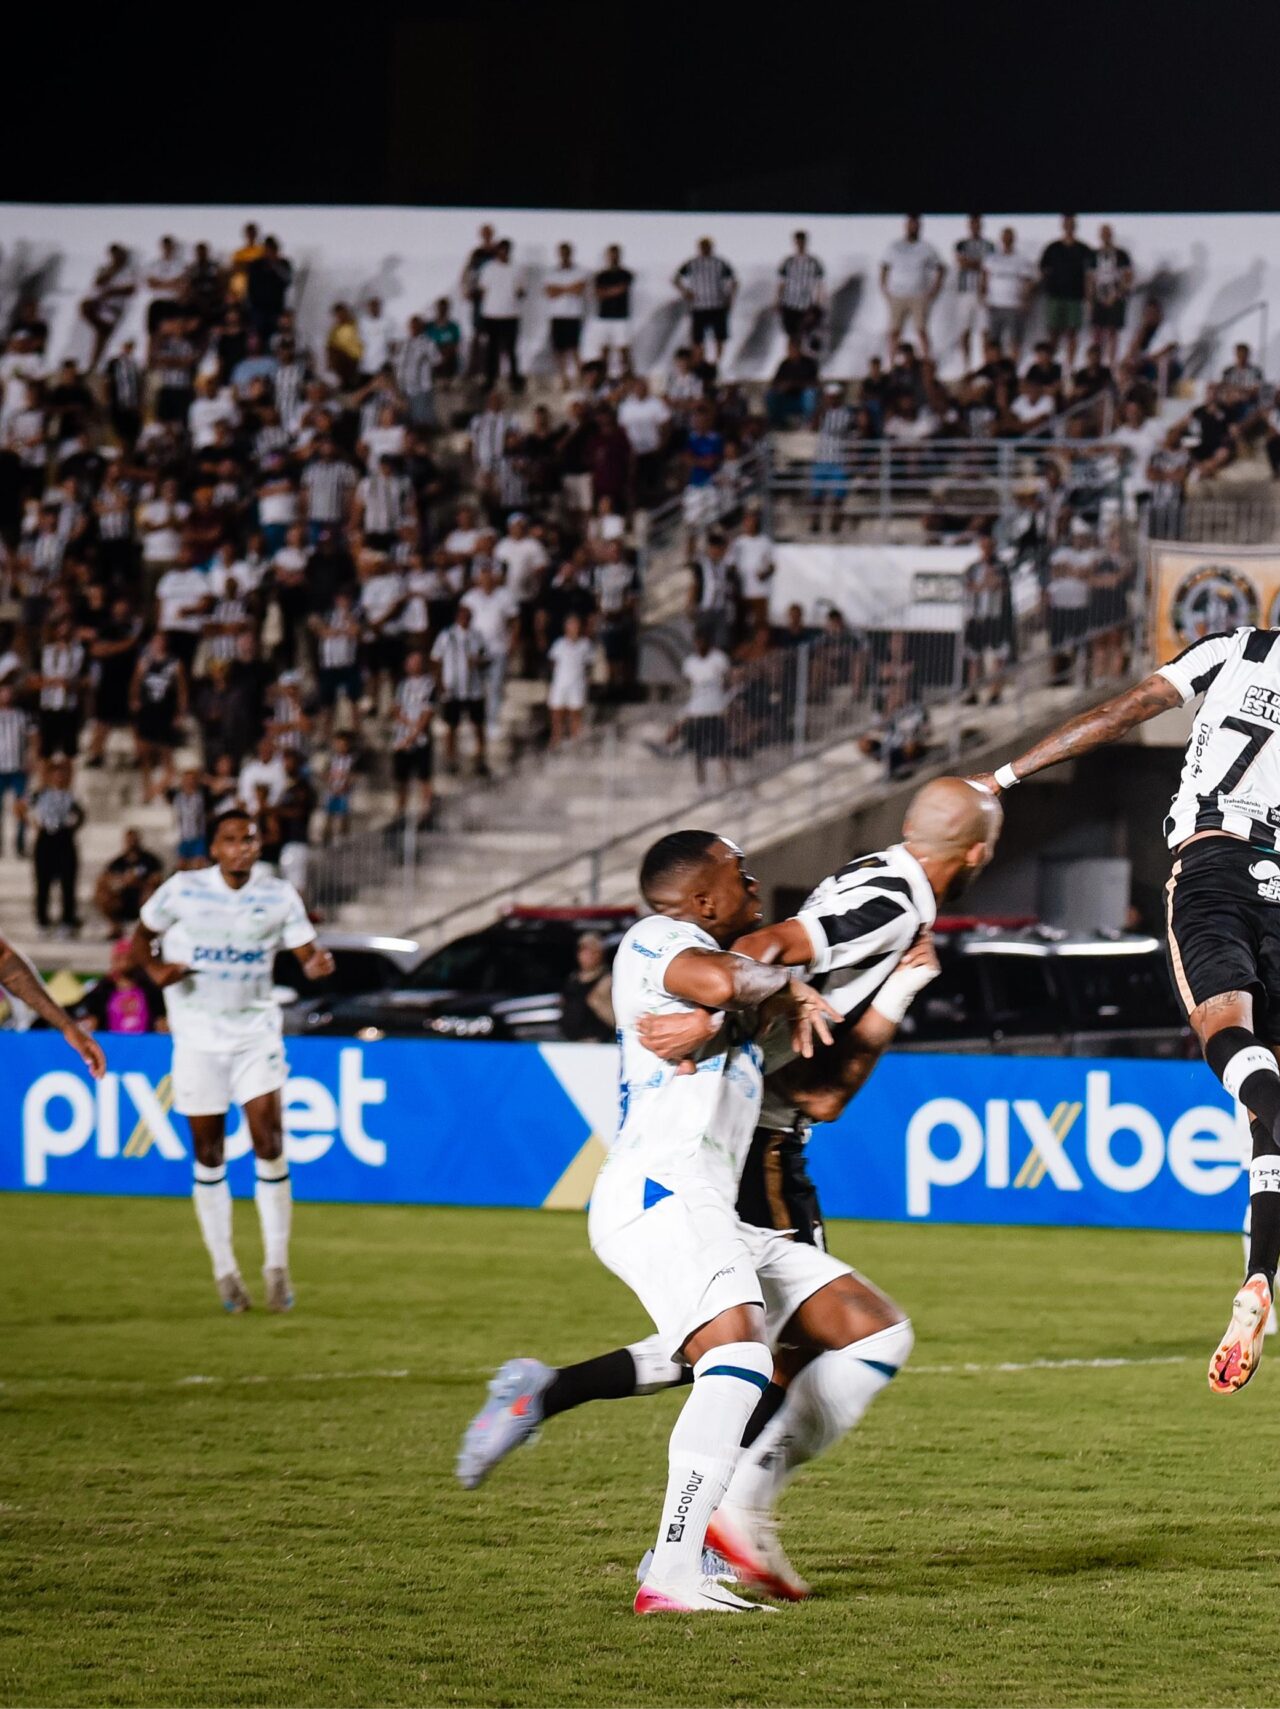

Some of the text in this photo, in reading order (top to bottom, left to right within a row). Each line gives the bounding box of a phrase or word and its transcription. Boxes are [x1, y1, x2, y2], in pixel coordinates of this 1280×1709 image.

[1245, 686, 1271, 704] PIX
[23, 1046, 387, 1186] pixet
[905, 1070, 1244, 1217] pixbe
[674, 1470, 704, 1523] Jcolour
